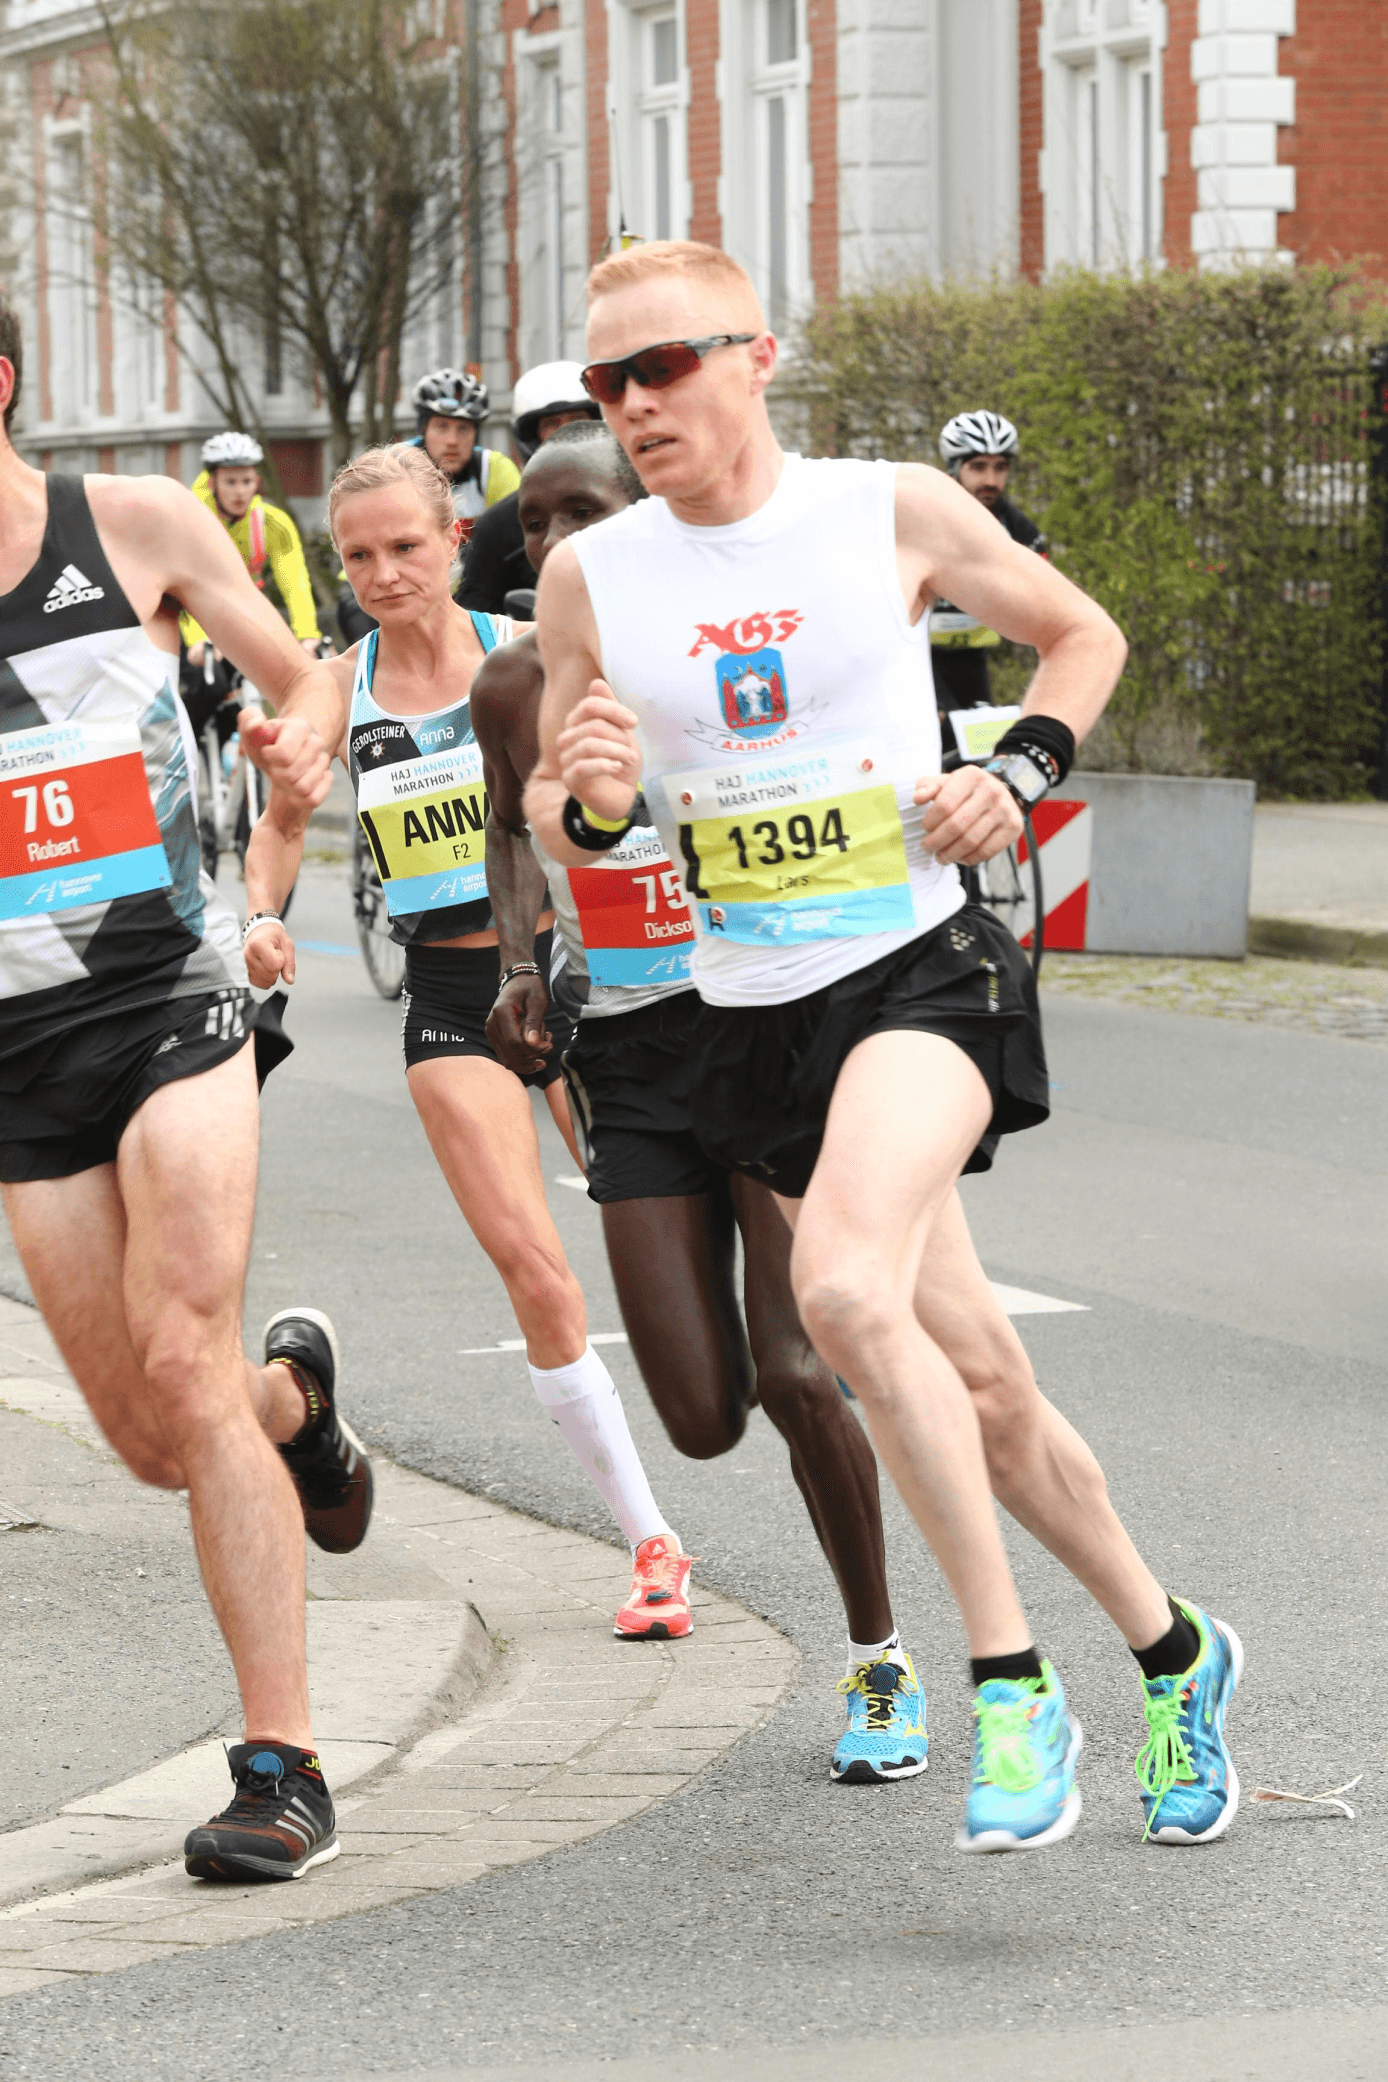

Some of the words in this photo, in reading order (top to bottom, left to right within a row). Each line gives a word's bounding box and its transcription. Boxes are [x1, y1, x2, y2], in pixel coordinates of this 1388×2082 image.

[43, 586, 105, 613] adidas
[351, 725, 406, 754] GEROLSTEINER
[0, 750, 55, 772] RATHON
[390, 768, 411, 782] HAJ
[413, 752, 476, 777] HANNOVER
[715, 774, 742, 792] HAJ
[745, 758, 828, 785] HANNOVER
[393, 772, 455, 796] MARATHON
[718, 782, 798, 808] MARATHON
[11, 779, 75, 834] 76
[26, 835, 81, 863] Robert
[452, 842, 472, 861] F2
[727, 807, 851, 869] 1394
[632, 869, 689, 914] 75
[776, 875, 810, 890] Lars
